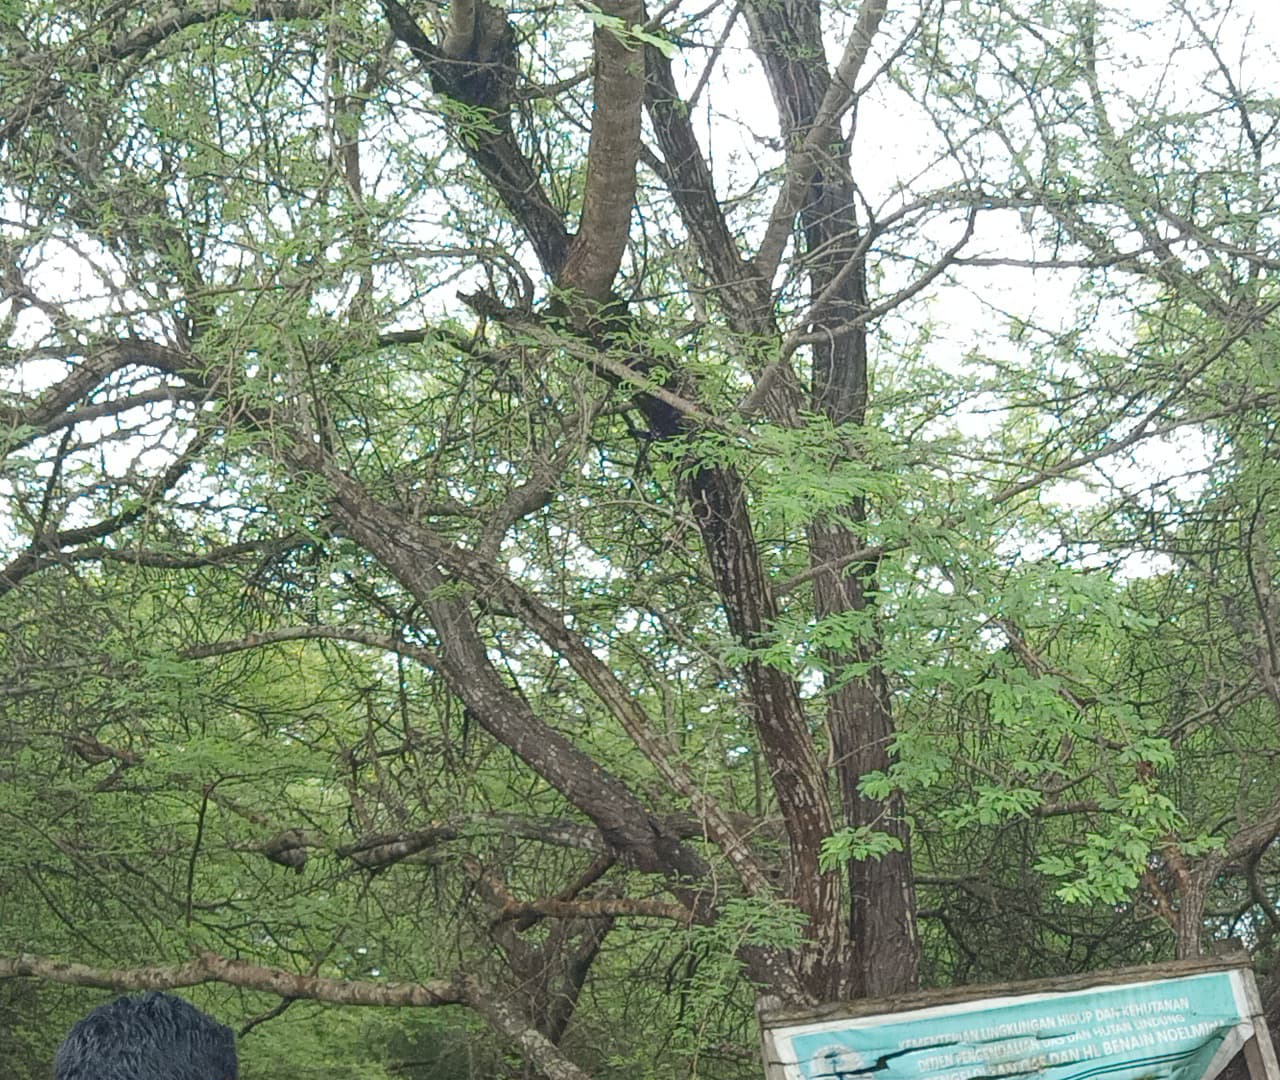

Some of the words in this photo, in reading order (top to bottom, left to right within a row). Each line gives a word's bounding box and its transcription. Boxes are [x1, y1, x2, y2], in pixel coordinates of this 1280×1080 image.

[981, 1015, 1055, 1040] LINGKUNGAN
[1057, 1010, 1093, 1027] HIDUP
[1122, 997, 1190, 1017] KEHUTANAN
[1049, 1047, 1081, 1067] DAN
[1103, 1033, 1154, 1056] BENAIN
